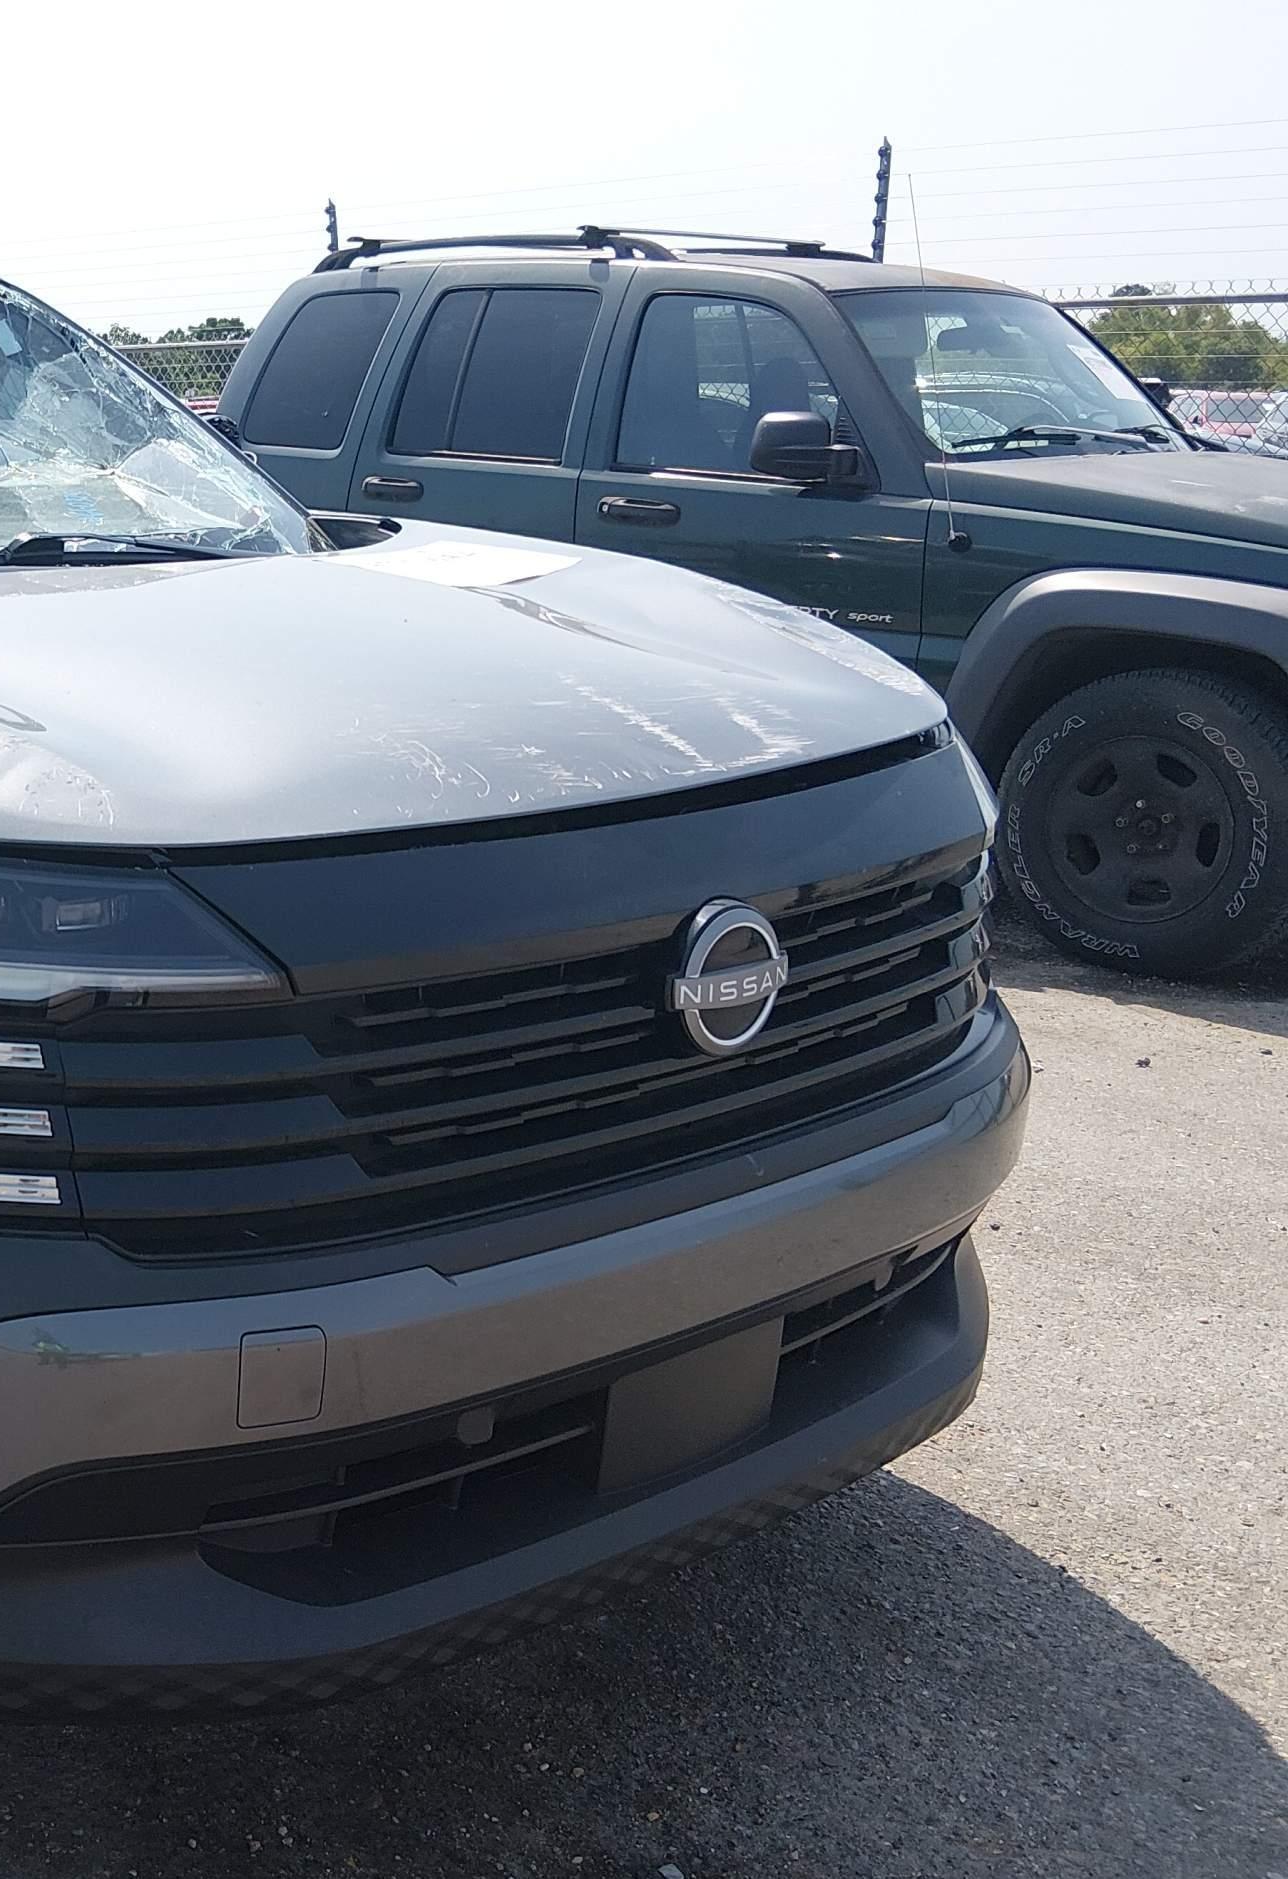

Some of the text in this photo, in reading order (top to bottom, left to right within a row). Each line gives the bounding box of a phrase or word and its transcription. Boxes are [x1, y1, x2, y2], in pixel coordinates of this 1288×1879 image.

[847, 612, 894, 623] sport
[1177, 712, 1267, 918] GOODYEAR
[1008, 803, 1141, 958] WRANGLER
[679, 965, 787, 1005] NISSAN
